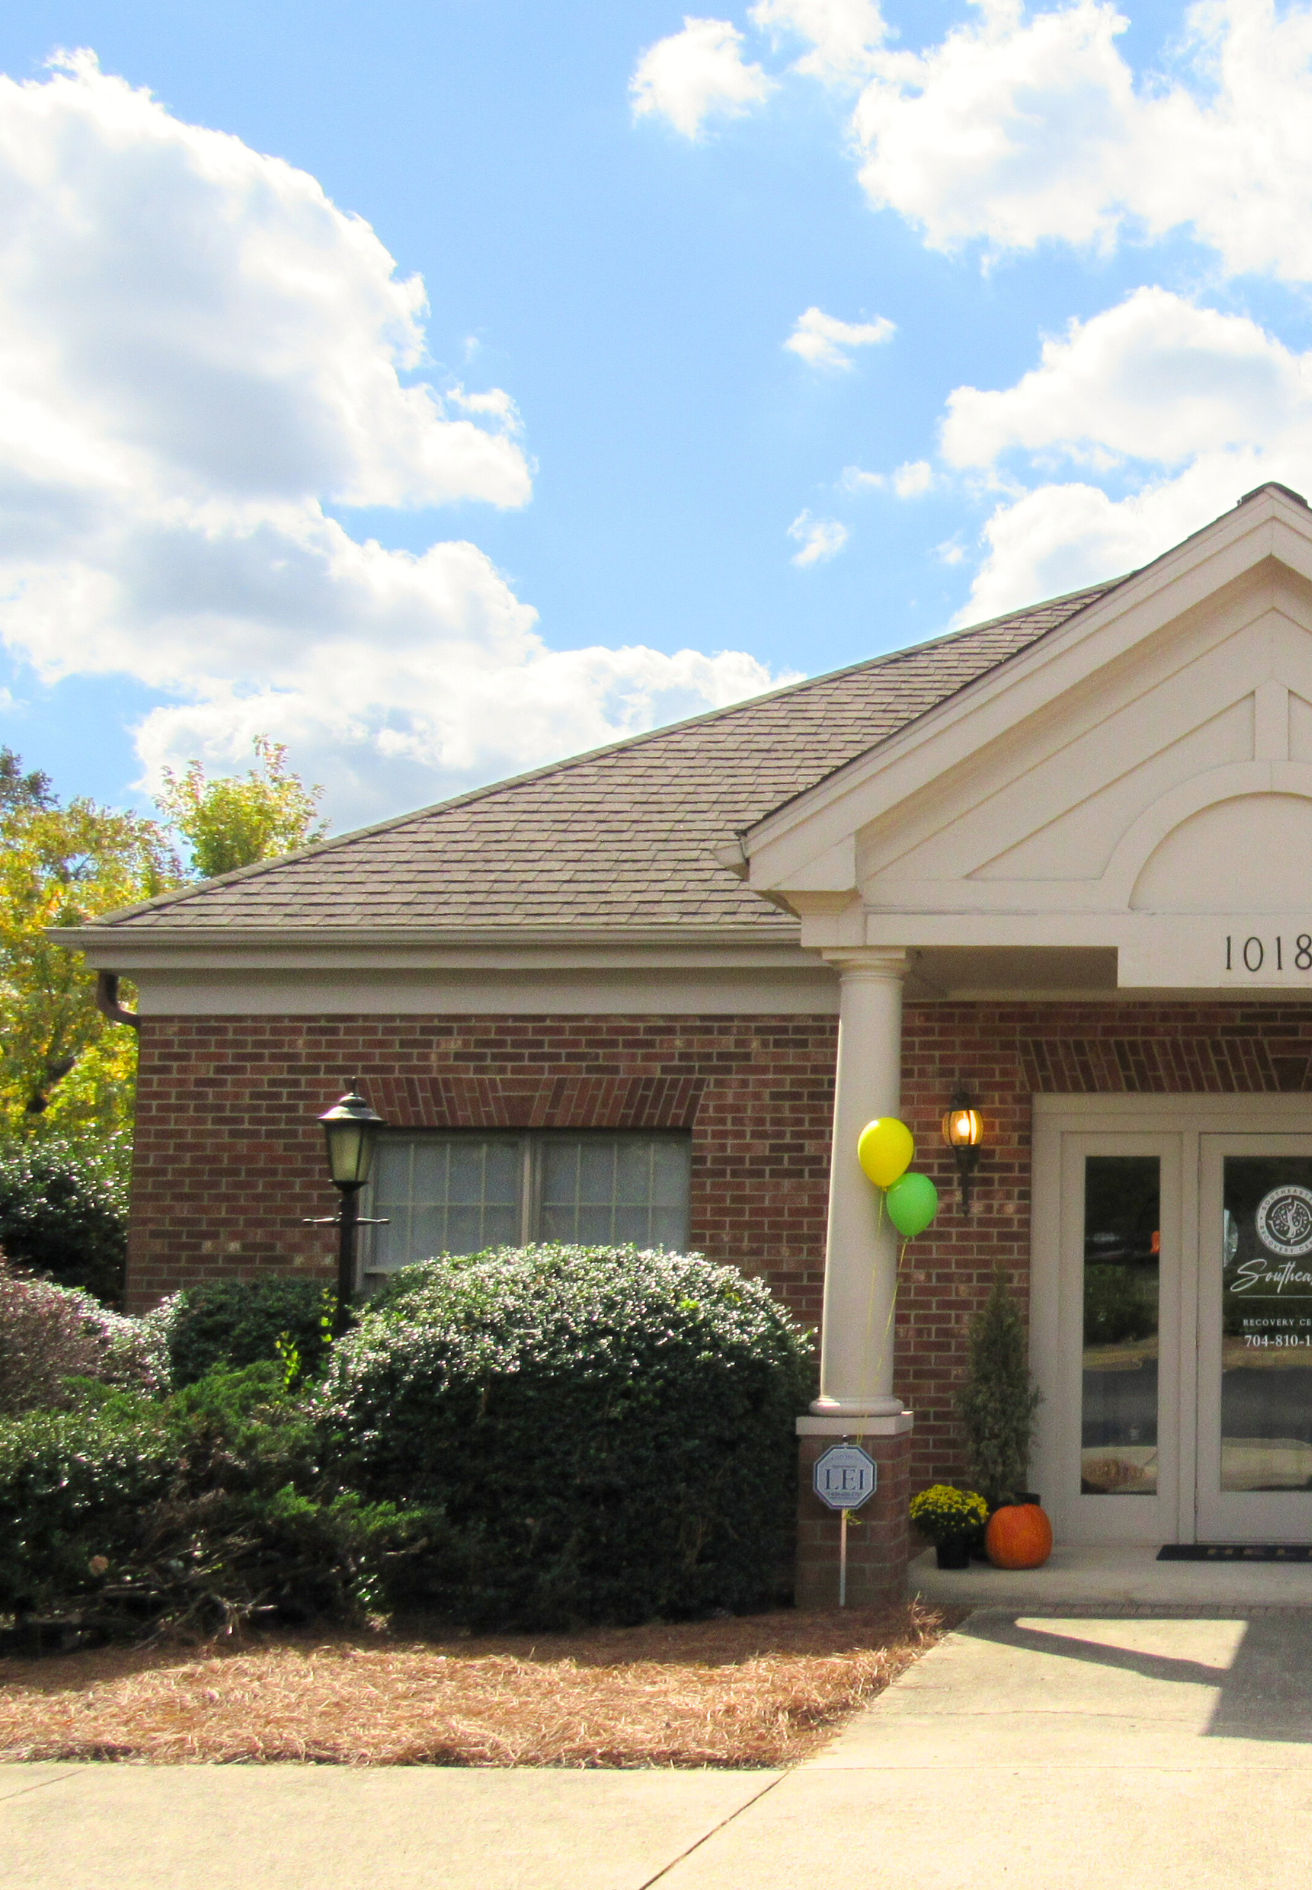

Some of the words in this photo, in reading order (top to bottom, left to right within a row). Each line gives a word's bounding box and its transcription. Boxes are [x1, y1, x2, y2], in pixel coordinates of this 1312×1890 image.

[1259, 1225, 1295, 1254] RECOVERY
[1242, 1318, 1295, 1327] RECOVERY
[824, 1468, 866, 1491] LEI
